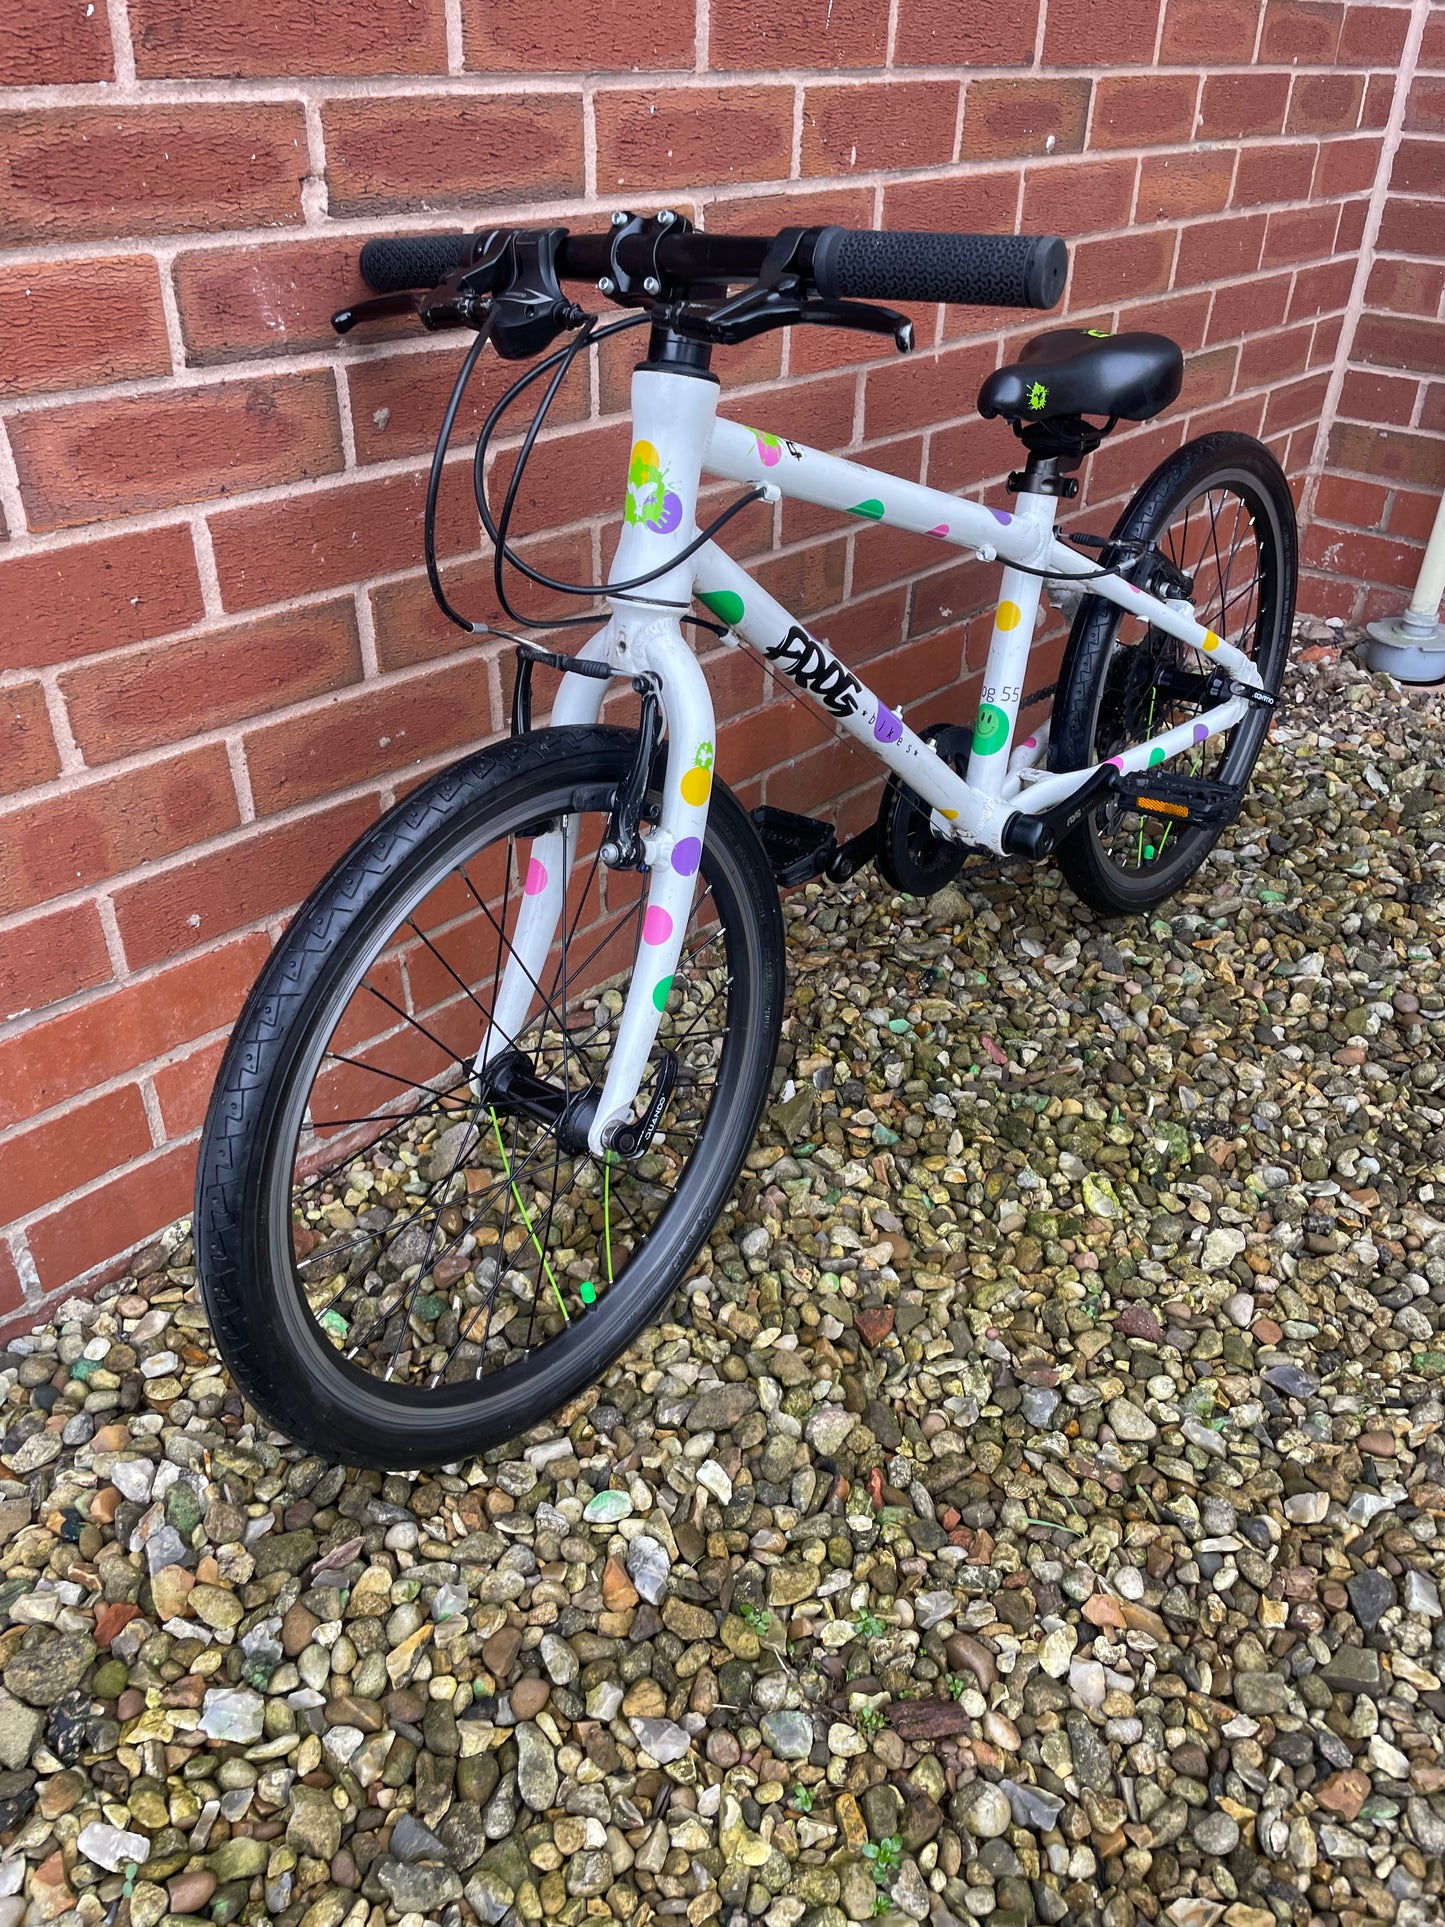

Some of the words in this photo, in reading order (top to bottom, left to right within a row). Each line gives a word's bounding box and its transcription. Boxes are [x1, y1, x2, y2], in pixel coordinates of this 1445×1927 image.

[762, 625, 862, 718] FROG
[1000, 686, 1020, 702] 55
[644, 1096, 666, 1141] QUANDO
